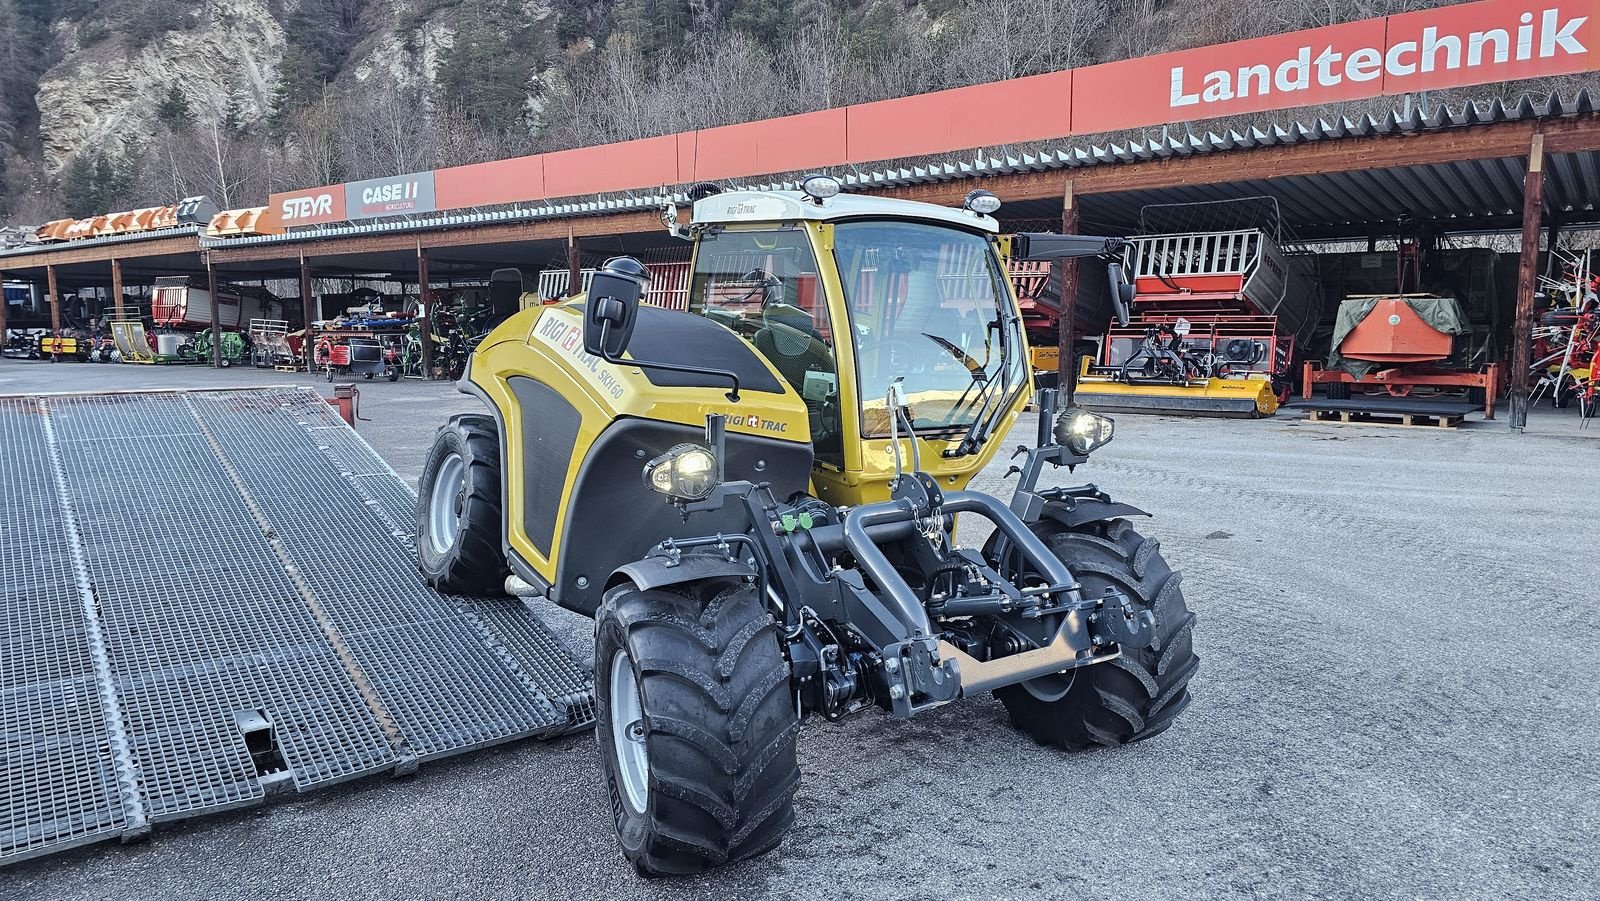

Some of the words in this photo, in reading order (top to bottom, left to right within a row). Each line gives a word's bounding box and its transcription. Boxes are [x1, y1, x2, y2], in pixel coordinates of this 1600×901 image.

[1170, 8, 1589, 107] Landtechnik
[362, 184, 402, 204] CASE
[385, 202, 415, 211] AGRICULTURE
[282, 194, 332, 220] STEYR
[540, 317, 568, 342] RIGI
[598, 369, 615, 390] SKH
[610, 384, 624, 400] 60
[724, 414, 745, 426] RIGI
[761, 420, 787, 432] TRAC
